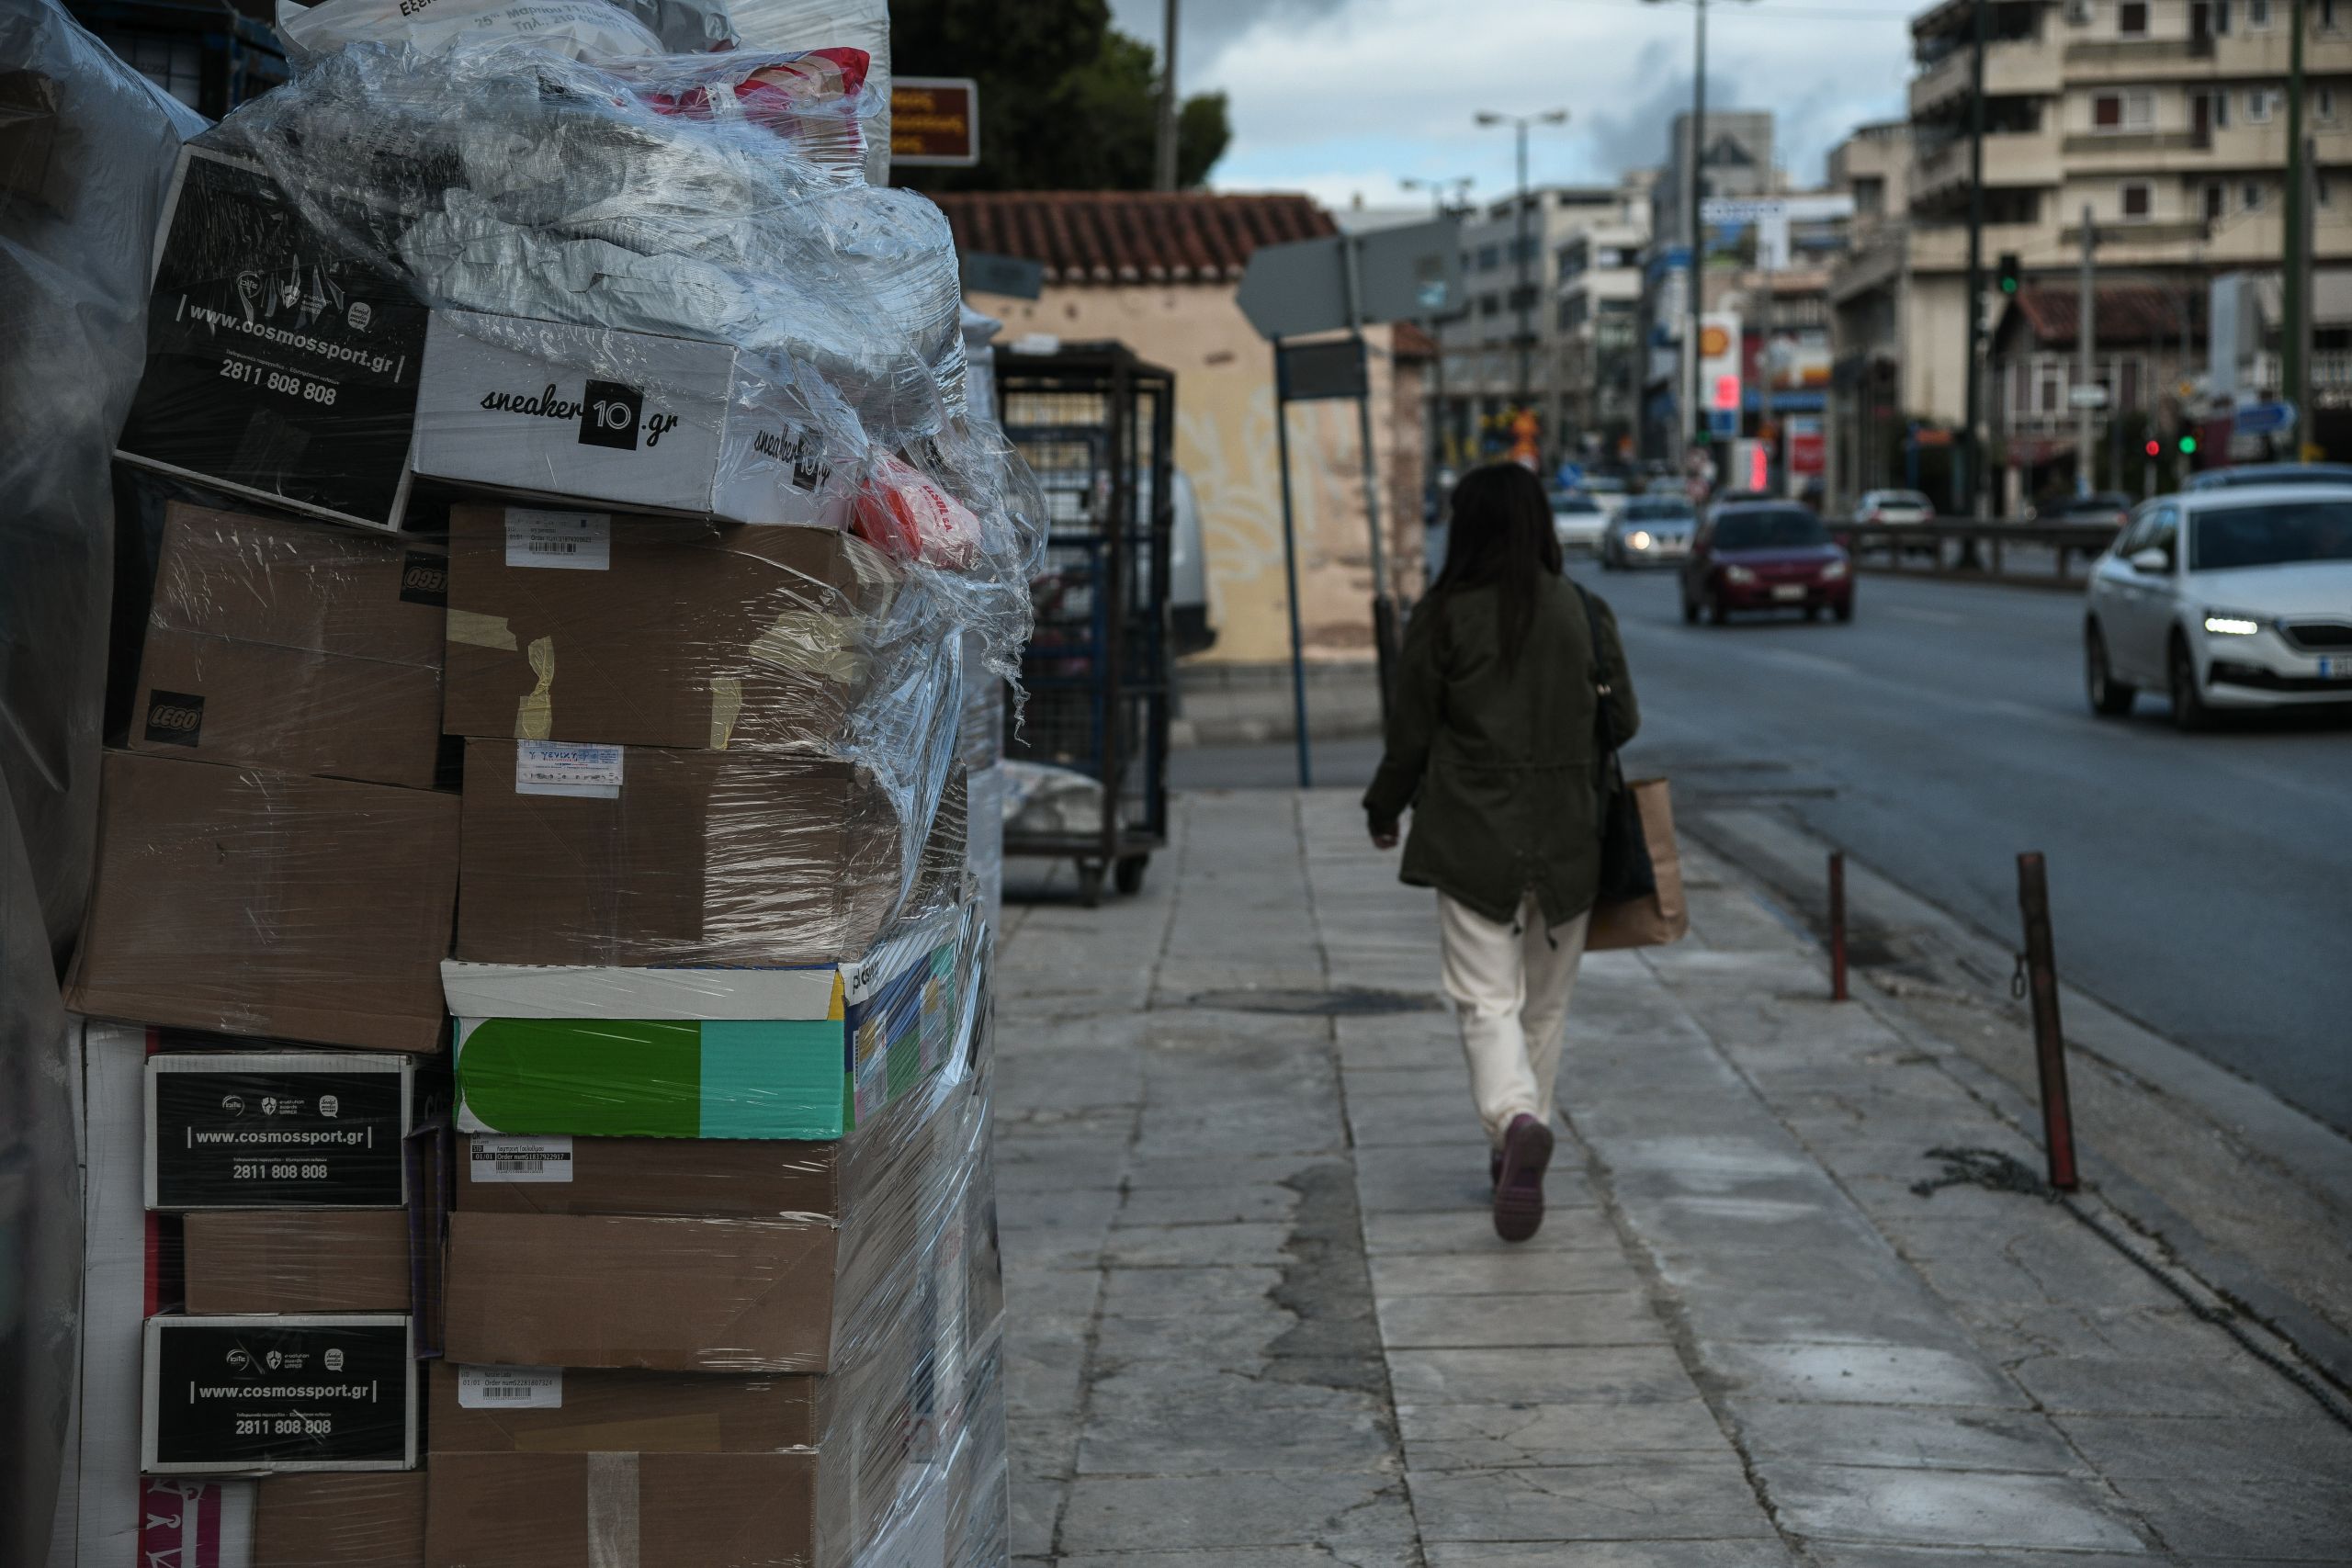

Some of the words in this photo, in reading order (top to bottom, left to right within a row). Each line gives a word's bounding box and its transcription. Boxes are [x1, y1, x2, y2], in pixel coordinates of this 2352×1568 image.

[190, 304, 393, 375] www.cosmossport.gr
[220, 358, 262, 386] 2811
[266, 371, 300, 396] 808
[303, 384, 337, 406] 808
[148, 705, 200, 731] LEGO
[196, 1130, 364, 1145] www.cosmossport.gr
[233, 1165, 266, 1179] 2811
[271, 1165, 298, 1179] 808
[301, 1165, 328, 1179] 808
[199, 1384, 368, 1400] www.cosmossport.gr
[235, 1419, 269, 1435] 2811
[274, 1419, 301, 1434] 808
[304, 1419, 332, 1434] 808
